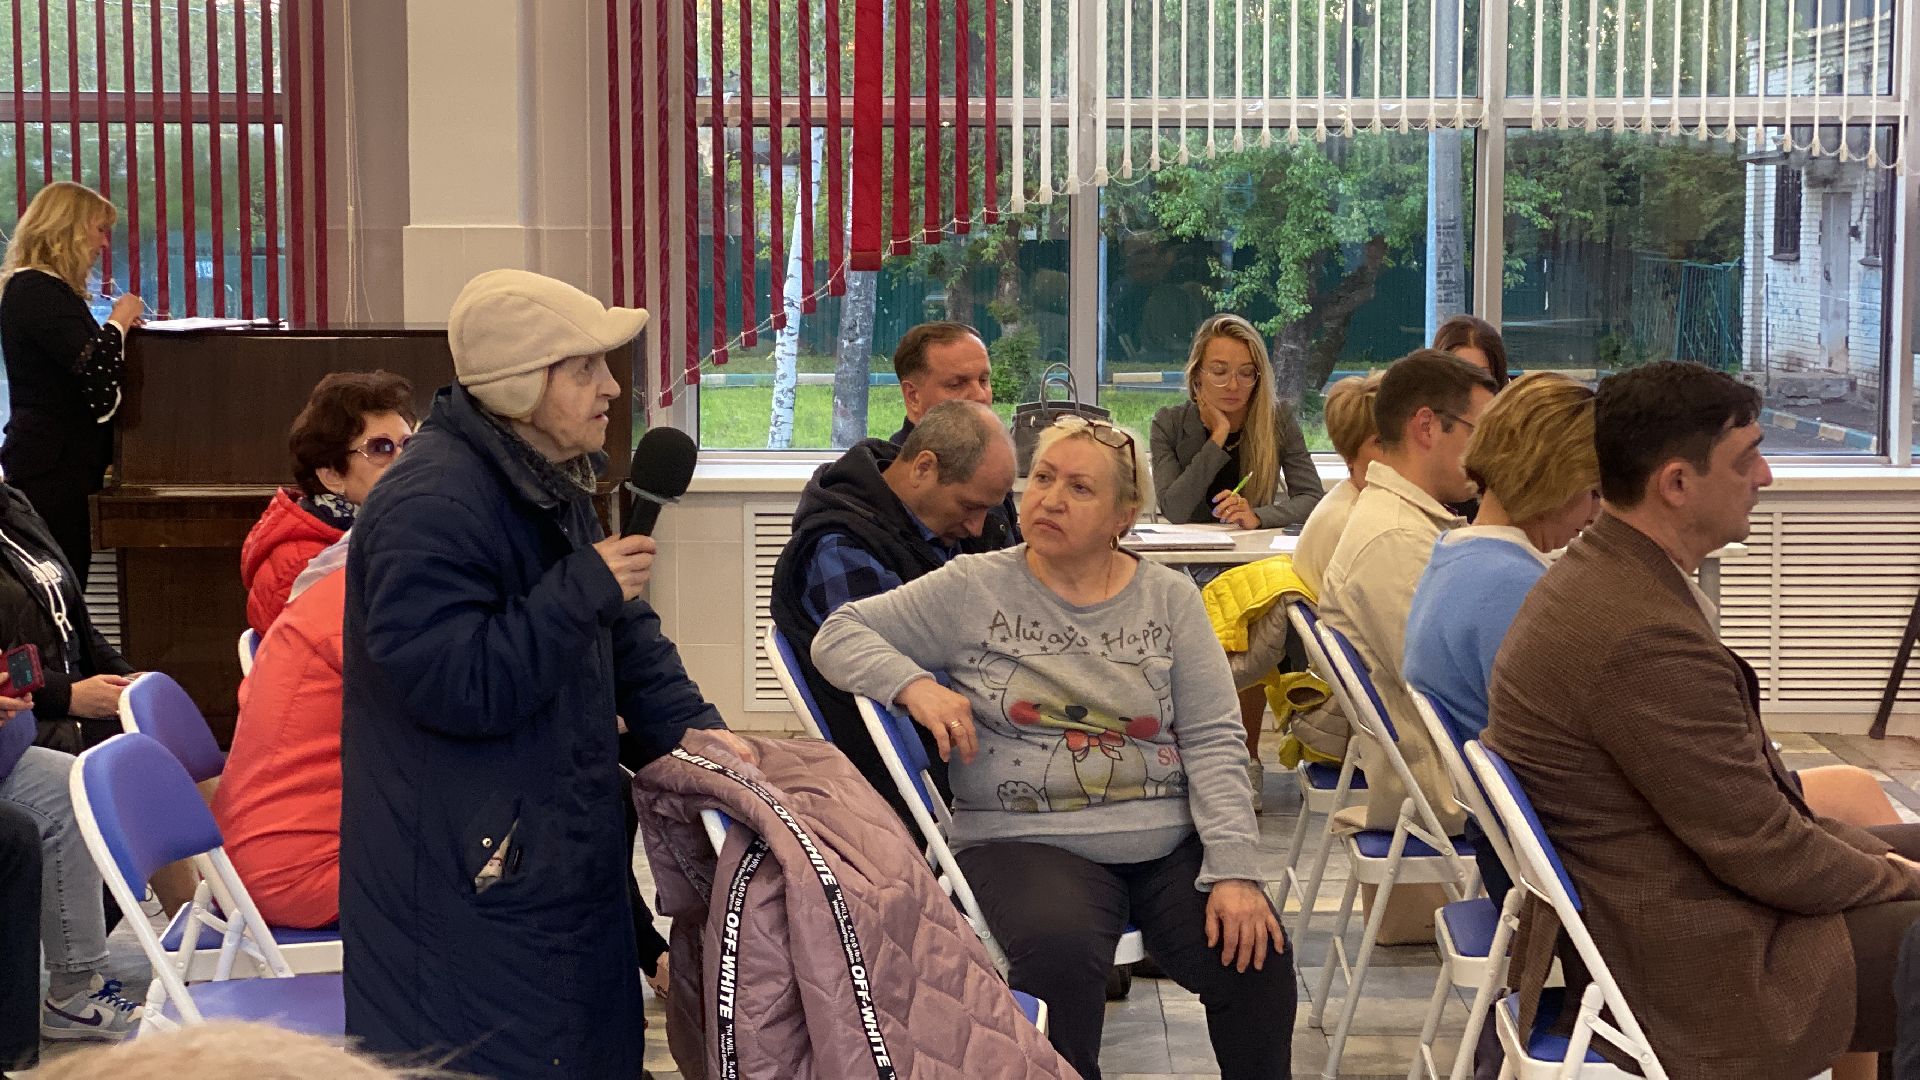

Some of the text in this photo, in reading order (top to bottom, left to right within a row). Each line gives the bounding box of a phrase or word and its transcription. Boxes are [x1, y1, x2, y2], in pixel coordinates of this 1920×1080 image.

[988, 610, 1090, 653] Always
[773, 805, 838, 886] OFF-WHITE
[835, 888, 844, 900] TM
[720, 912, 740, 1020] OFF-WHITE
[725, 1023, 733, 1036] TM
[851, 965, 891, 1068] OFF-WHITE
[726, 1037, 735, 1057] WILL
